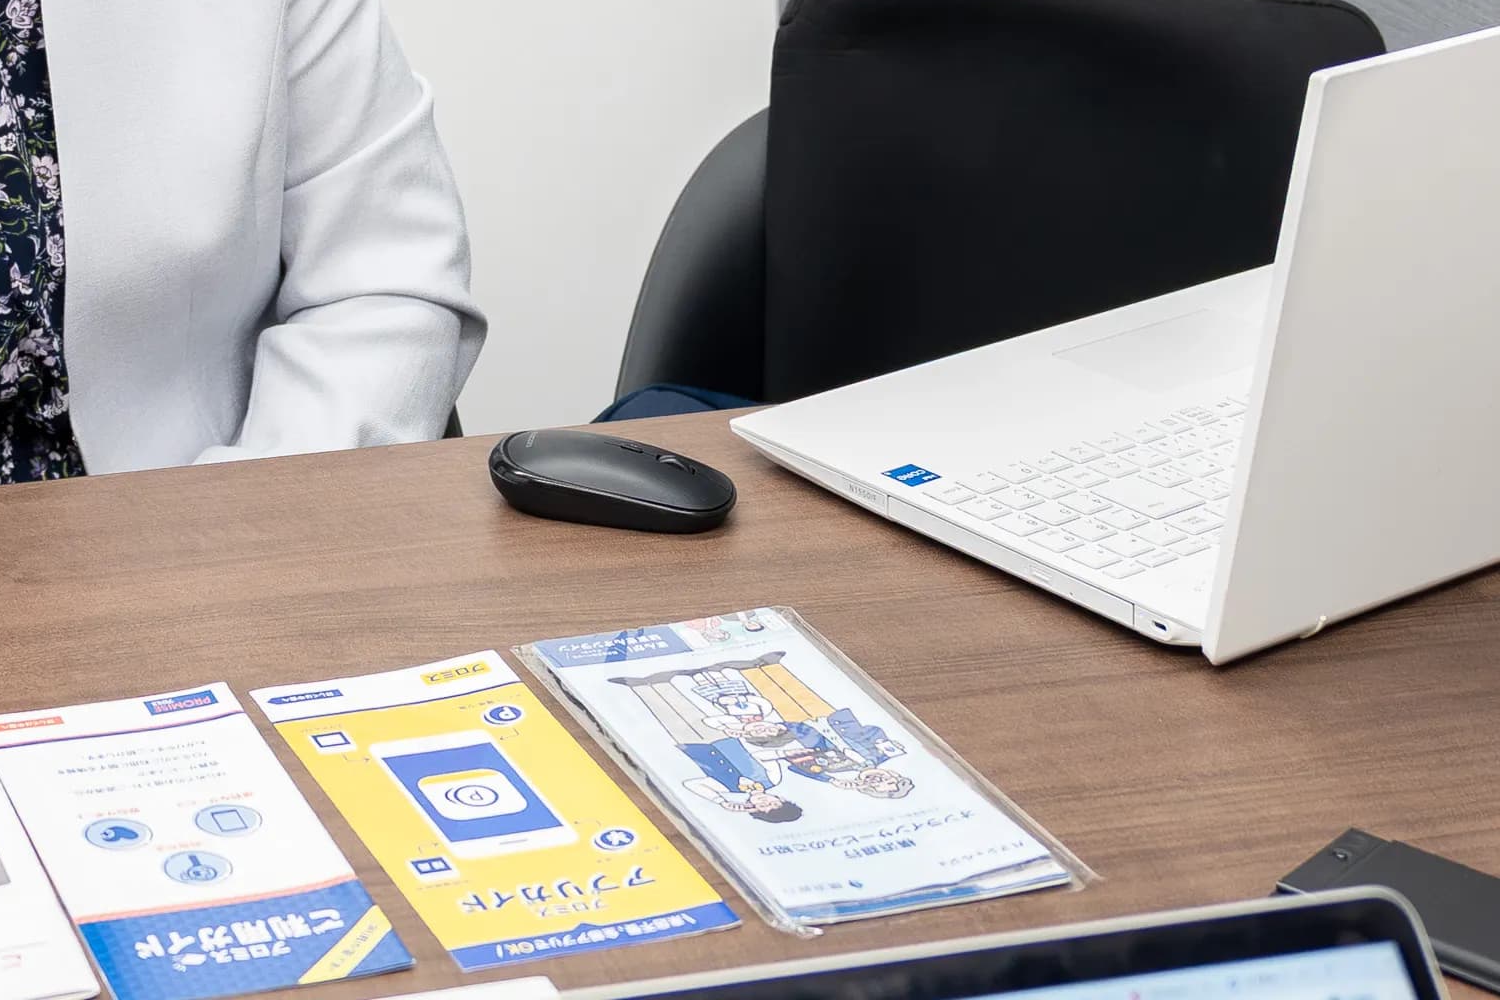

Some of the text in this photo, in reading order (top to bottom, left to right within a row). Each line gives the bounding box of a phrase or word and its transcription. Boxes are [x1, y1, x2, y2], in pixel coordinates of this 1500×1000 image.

[426, 664, 484, 683] プロミス
[154, 695, 211, 713] PROMISE
[757, 810, 974, 856] オンラインサービスのご紹介
[843, 838, 916, 860] 横浜銀行
[461, 867, 656, 914] アプリガイド
[537, 900, 607, 918] プロミス
[133, 908, 344, 960] ご利用ガイド
[208, 941, 291, 963] プロミス
